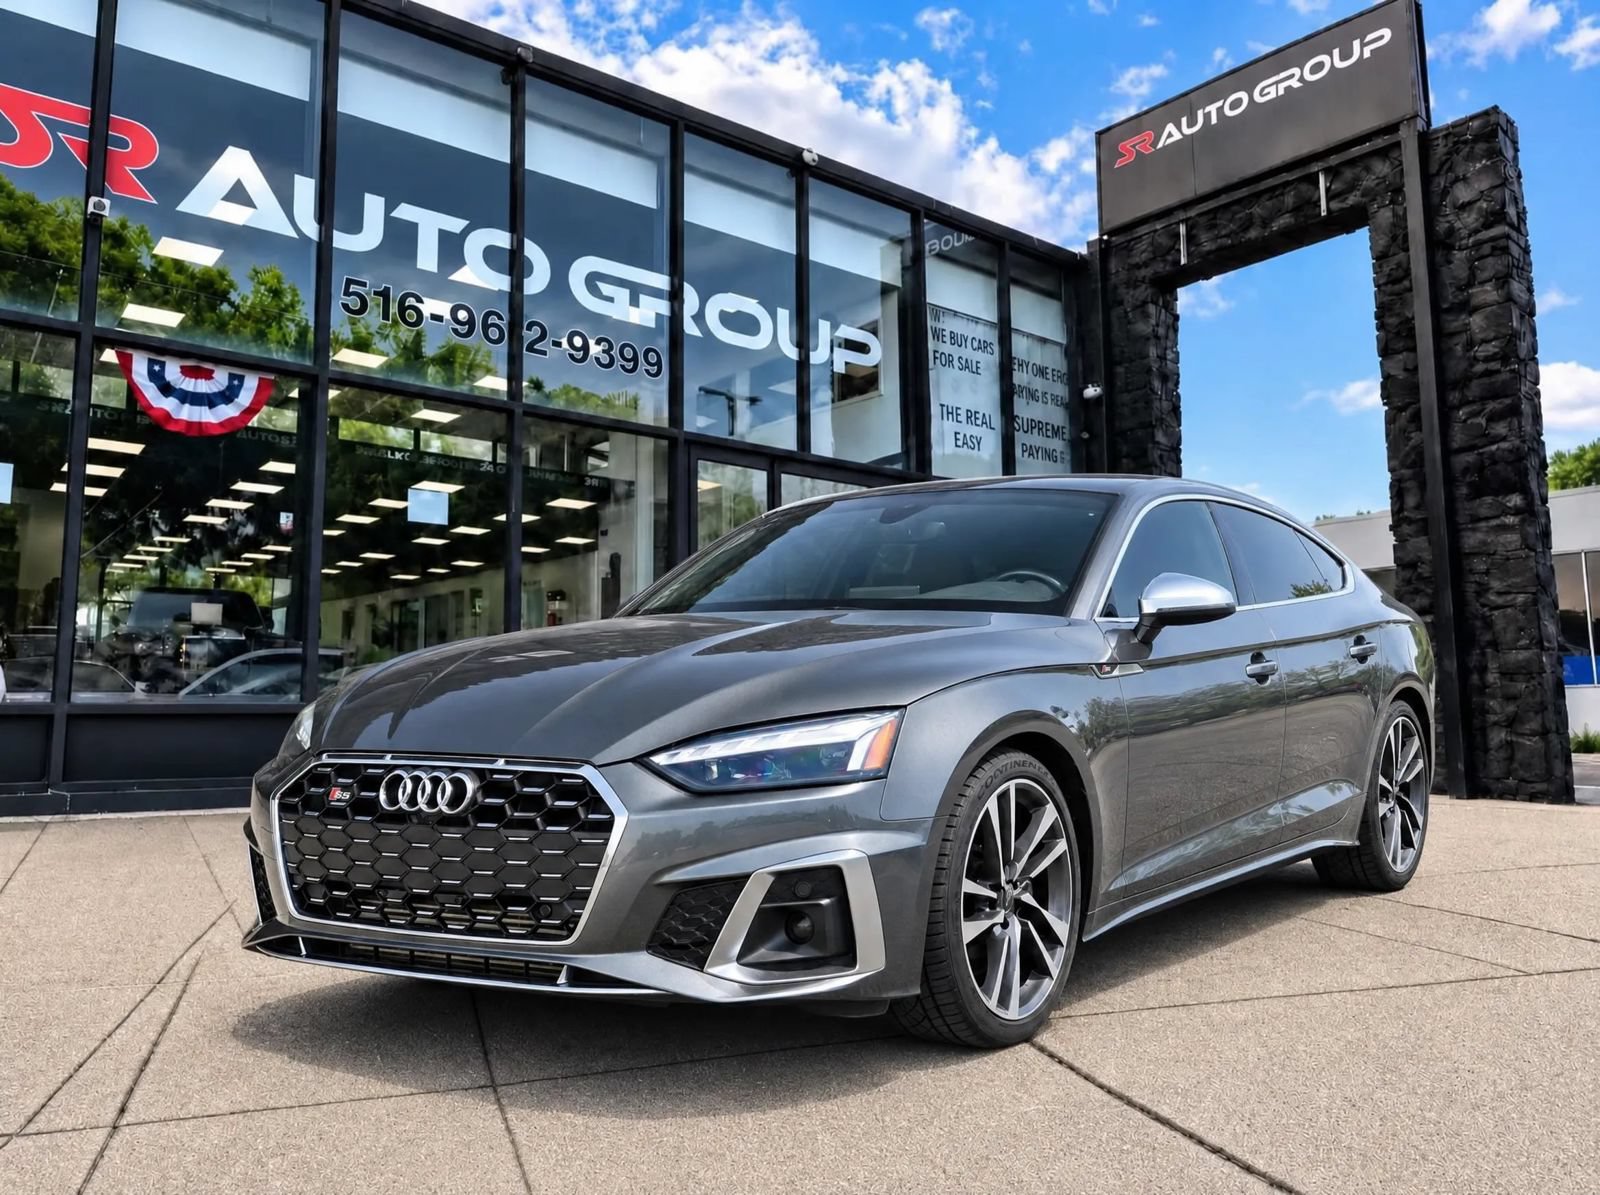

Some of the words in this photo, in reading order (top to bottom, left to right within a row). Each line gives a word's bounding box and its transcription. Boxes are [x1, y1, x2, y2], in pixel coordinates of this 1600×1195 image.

[1114, 130, 1155, 168] SR
[1156, 90, 1249, 150] AUTO
[1253, 27, 1392, 103] GROUP
[176, 145, 551, 295] AUTO
[568, 255, 882, 373] GROUP
[930, 325, 947, 344] WE
[949, 330, 970, 350] BUY
[970, 336, 995, 356] CARS
[932, 350, 955, 370] FOR
[957, 356, 982, 376] SALE
[1031, 362, 1050, 381] ONE
[939, 403, 963, 424] THE
[965, 408, 996, 431] REAL
[954, 431, 982, 452] EASY
[1021, 442, 1058, 464] PAYING
